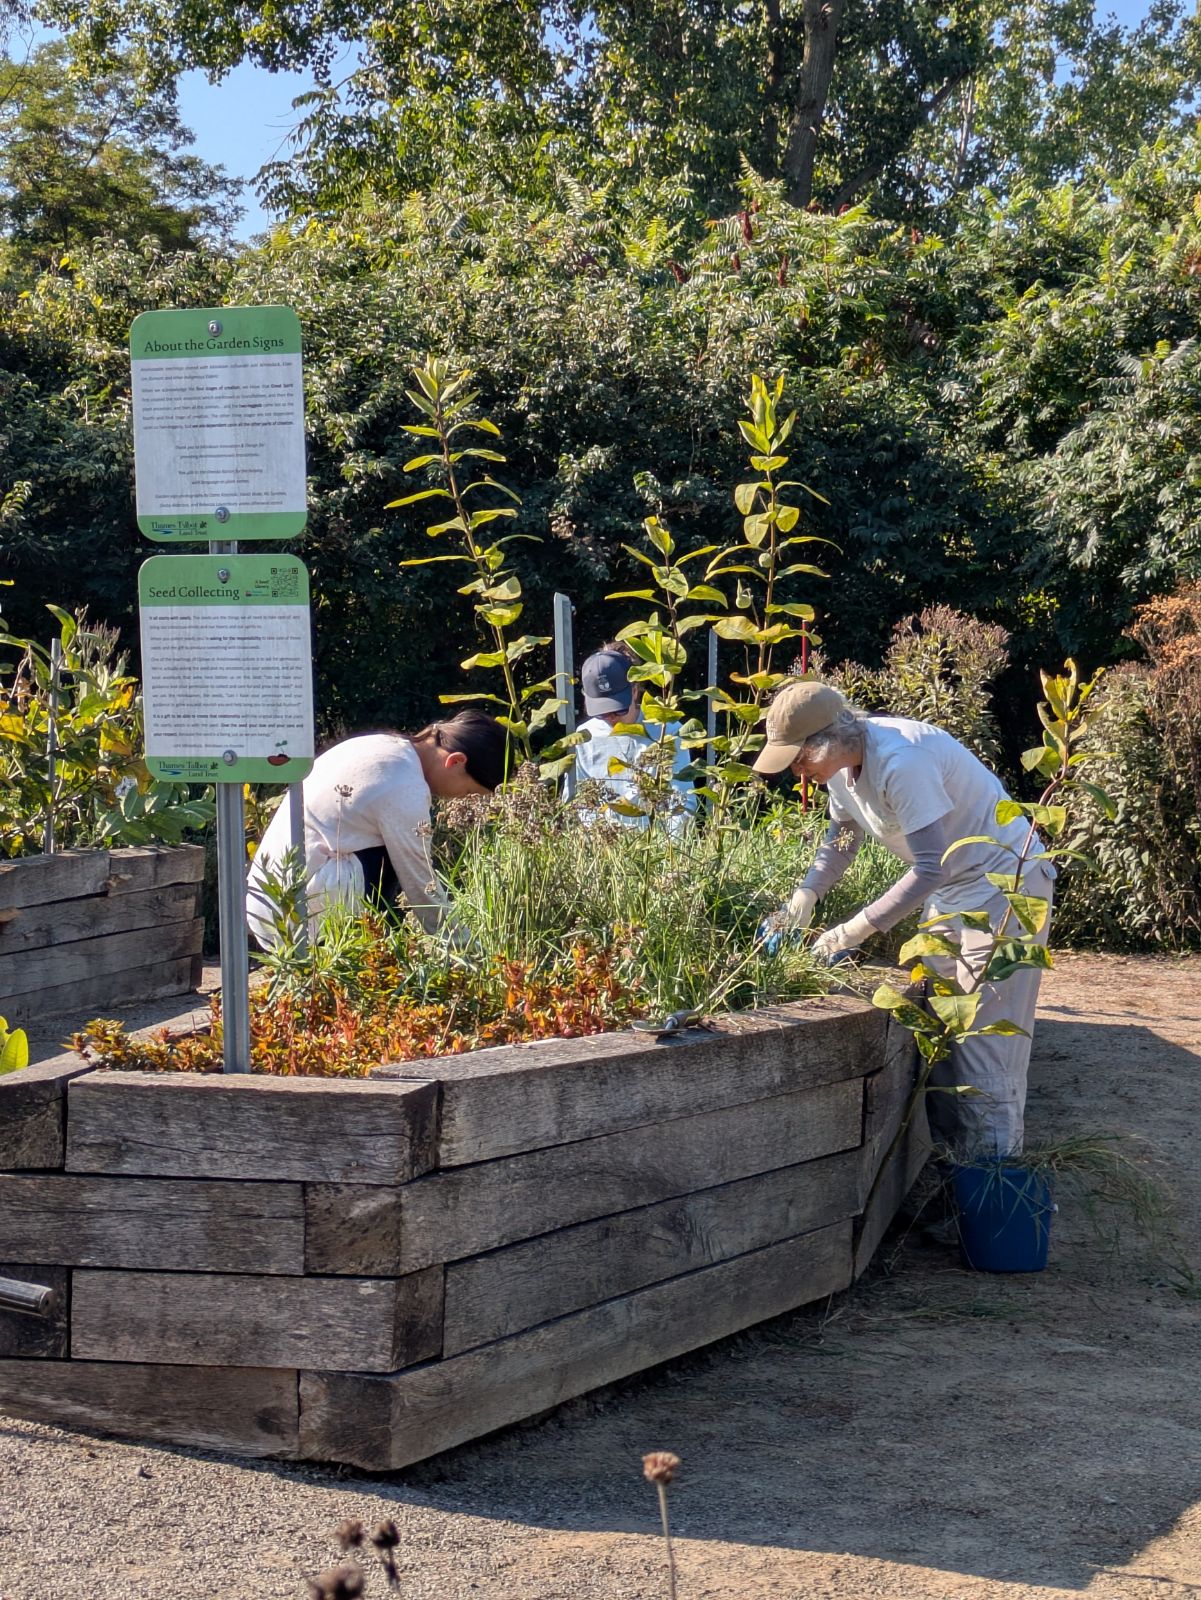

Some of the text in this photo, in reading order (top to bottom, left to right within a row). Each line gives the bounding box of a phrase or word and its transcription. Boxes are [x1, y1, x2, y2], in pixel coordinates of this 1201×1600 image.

[144, 336, 284, 352] About the Garden Signs
[149, 586, 176, 598] Seed
[178, 586, 240, 600] Collecting
